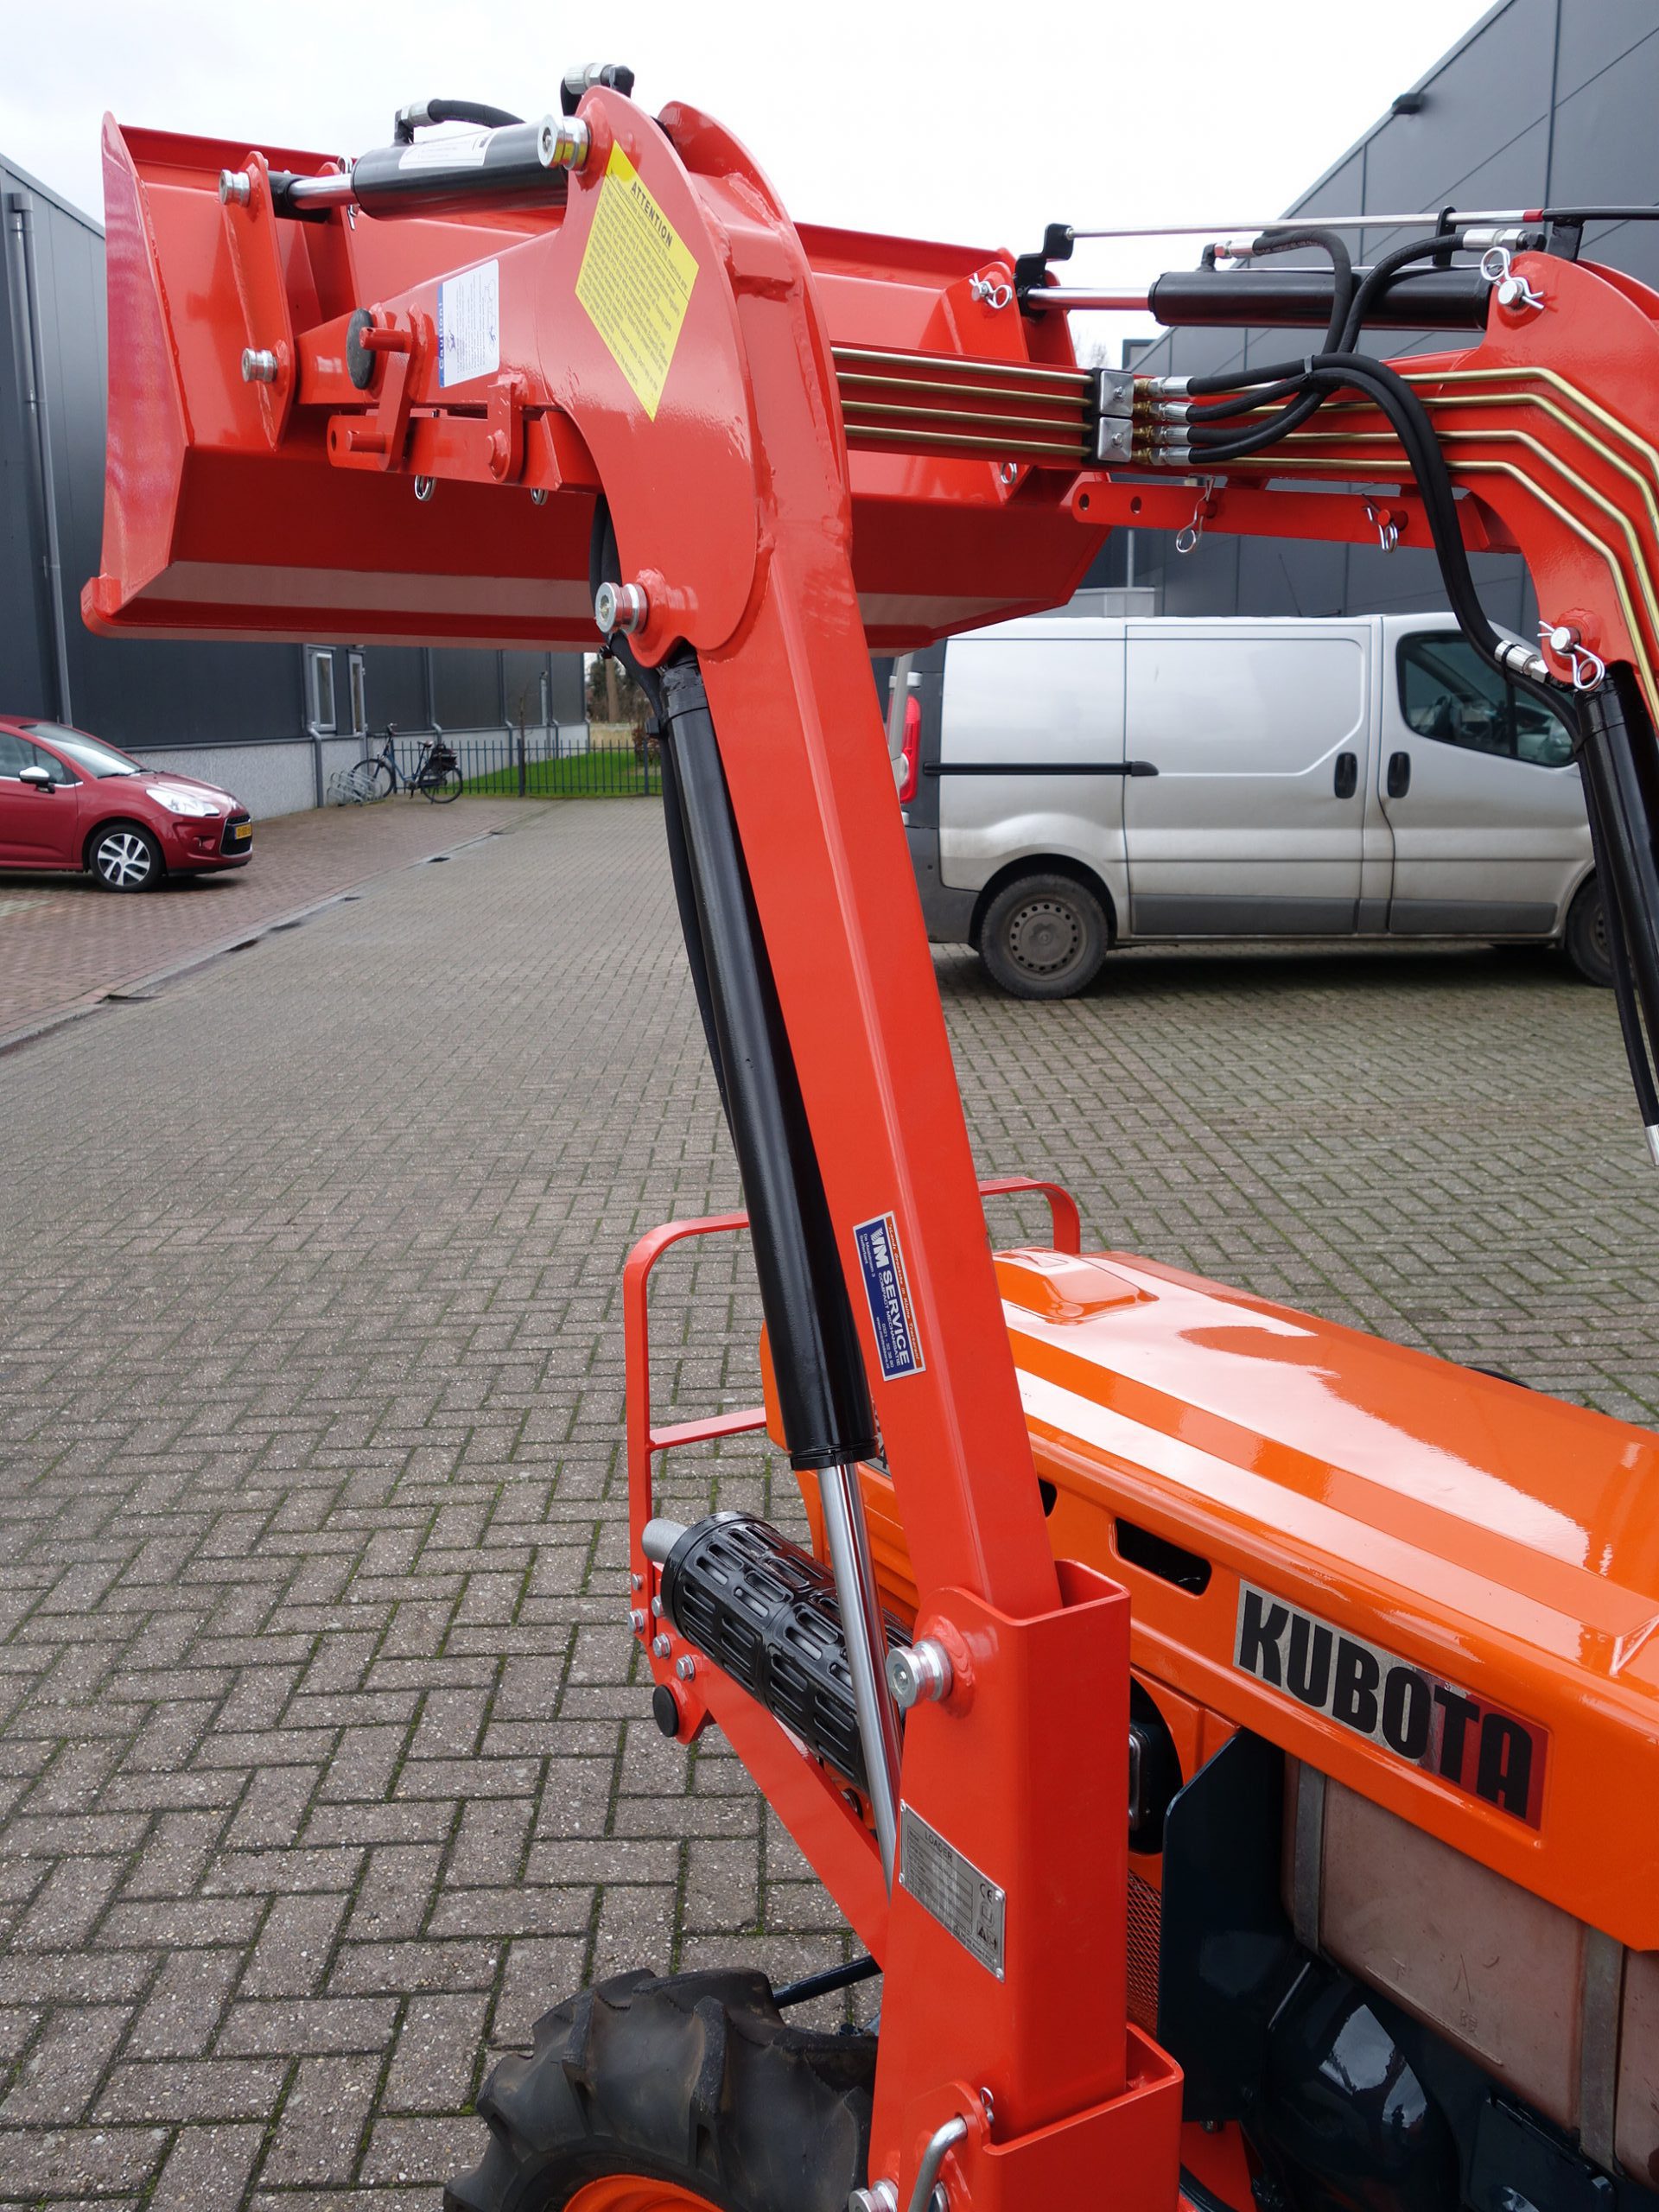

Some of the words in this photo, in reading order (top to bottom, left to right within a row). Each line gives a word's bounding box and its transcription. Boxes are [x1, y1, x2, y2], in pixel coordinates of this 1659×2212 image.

[631, 181, 672, 248] ATTENTION
[877, 1272, 889, 1309] COMPACT
[886, 1310, 900, 1366] MECHANISATIE
[881, 1268, 910, 1365] SERVICE
[1239, 1590, 1533, 1820] KUBOTA
[925, 1831, 953, 1862] LOADER
